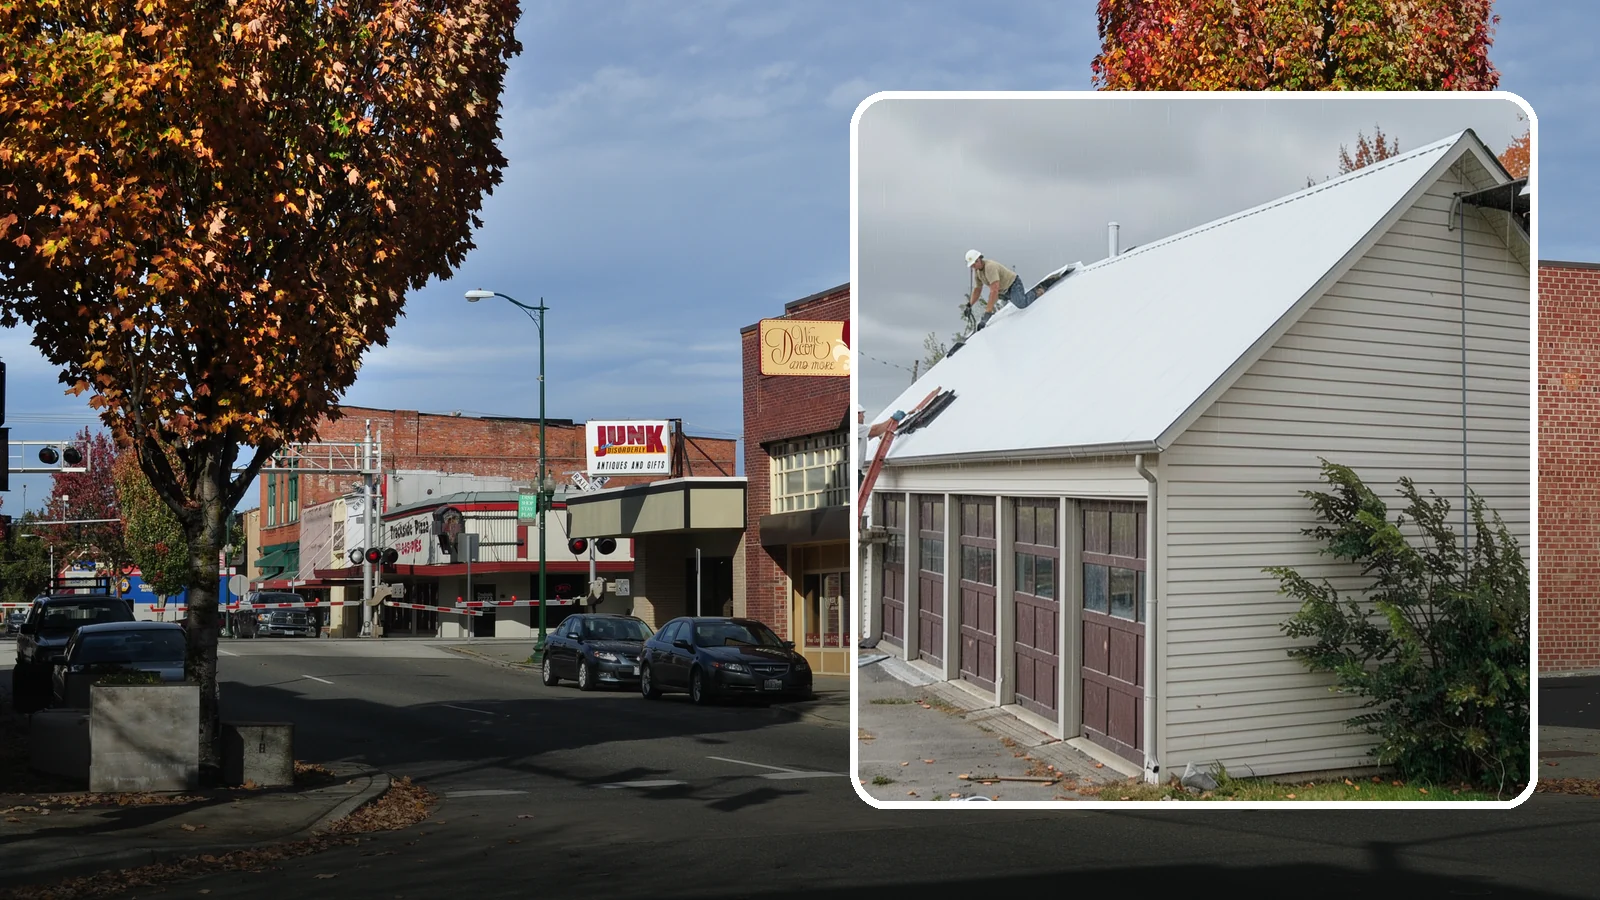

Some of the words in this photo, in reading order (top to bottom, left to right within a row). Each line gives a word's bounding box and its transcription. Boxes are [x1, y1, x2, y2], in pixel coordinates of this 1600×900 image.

[596, 425, 665, 457] JUNK
[607, 446, 646, 454] DISORDERLY
[596, 461, 628, 470] ANTIQUES
[631, 461, 643, 470] AND
[646, 461, 665, 470] GIFTS
[414, 519, 429, 535] Pizza
